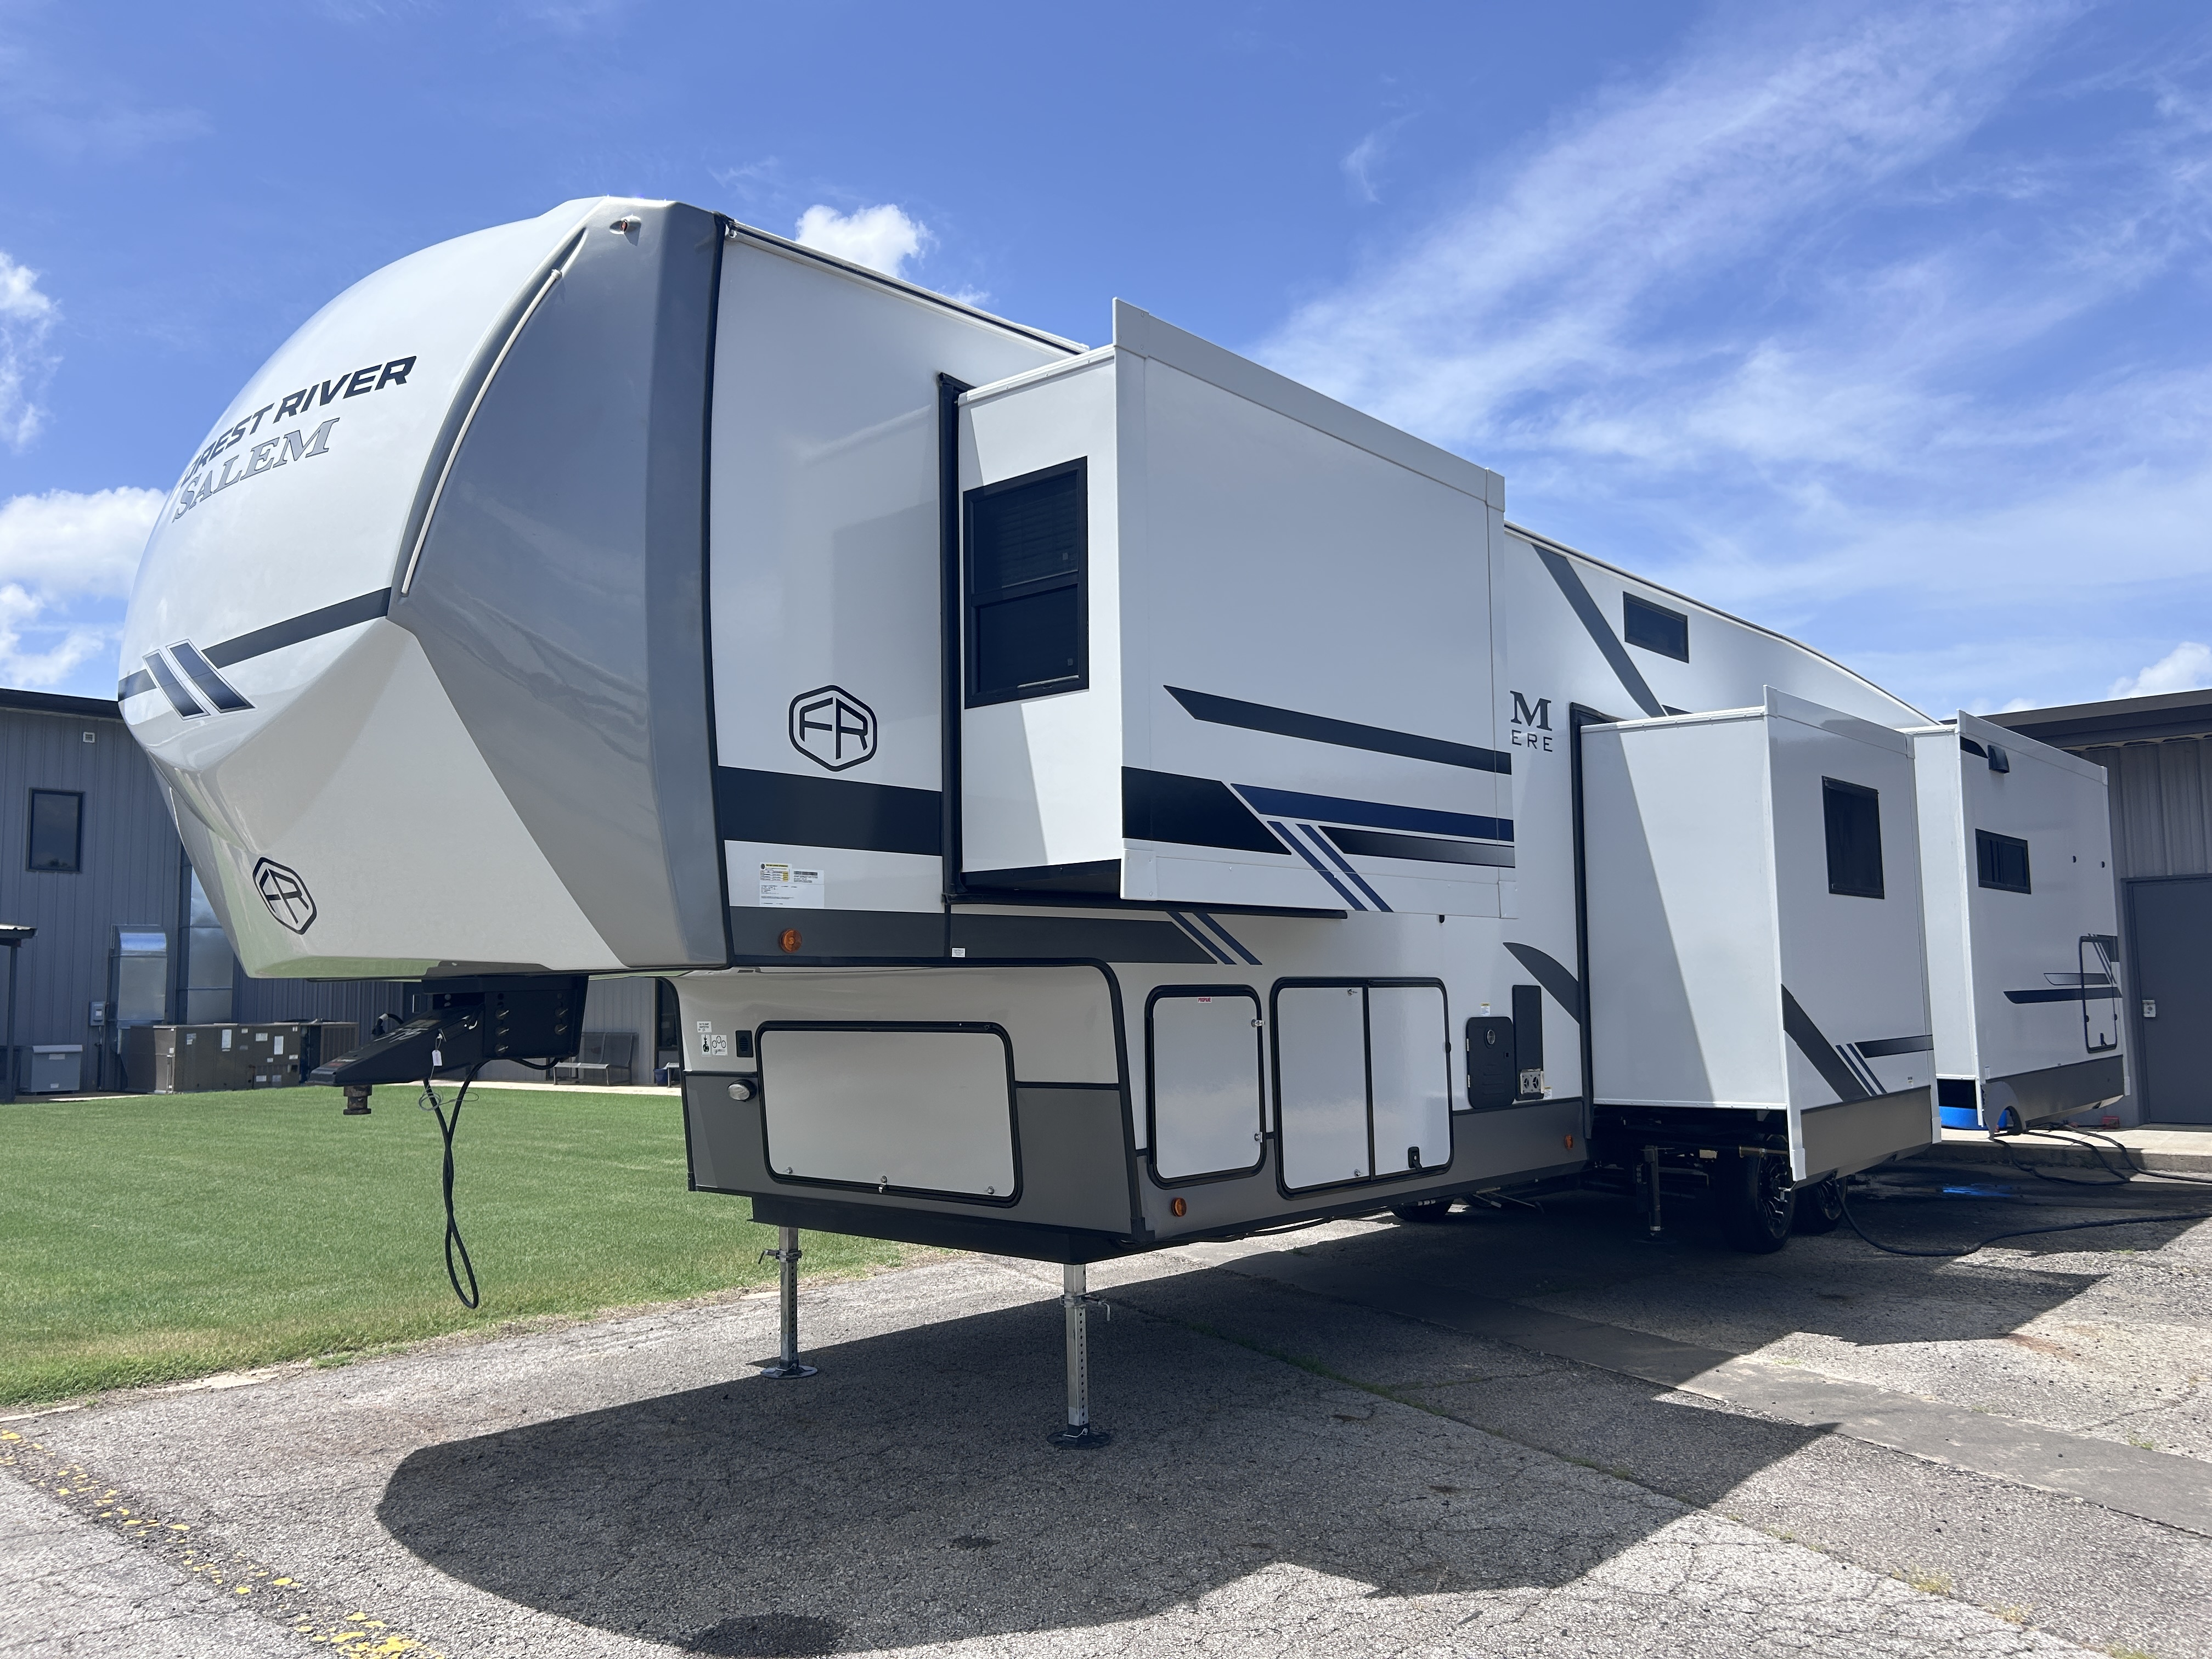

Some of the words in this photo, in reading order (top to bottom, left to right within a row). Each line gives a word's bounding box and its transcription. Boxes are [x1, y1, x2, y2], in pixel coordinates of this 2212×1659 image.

[273, 356, 417, 424] RIVER
[172, 417, 340, 523] SALEM
[799, 697, 868, 760] FR
